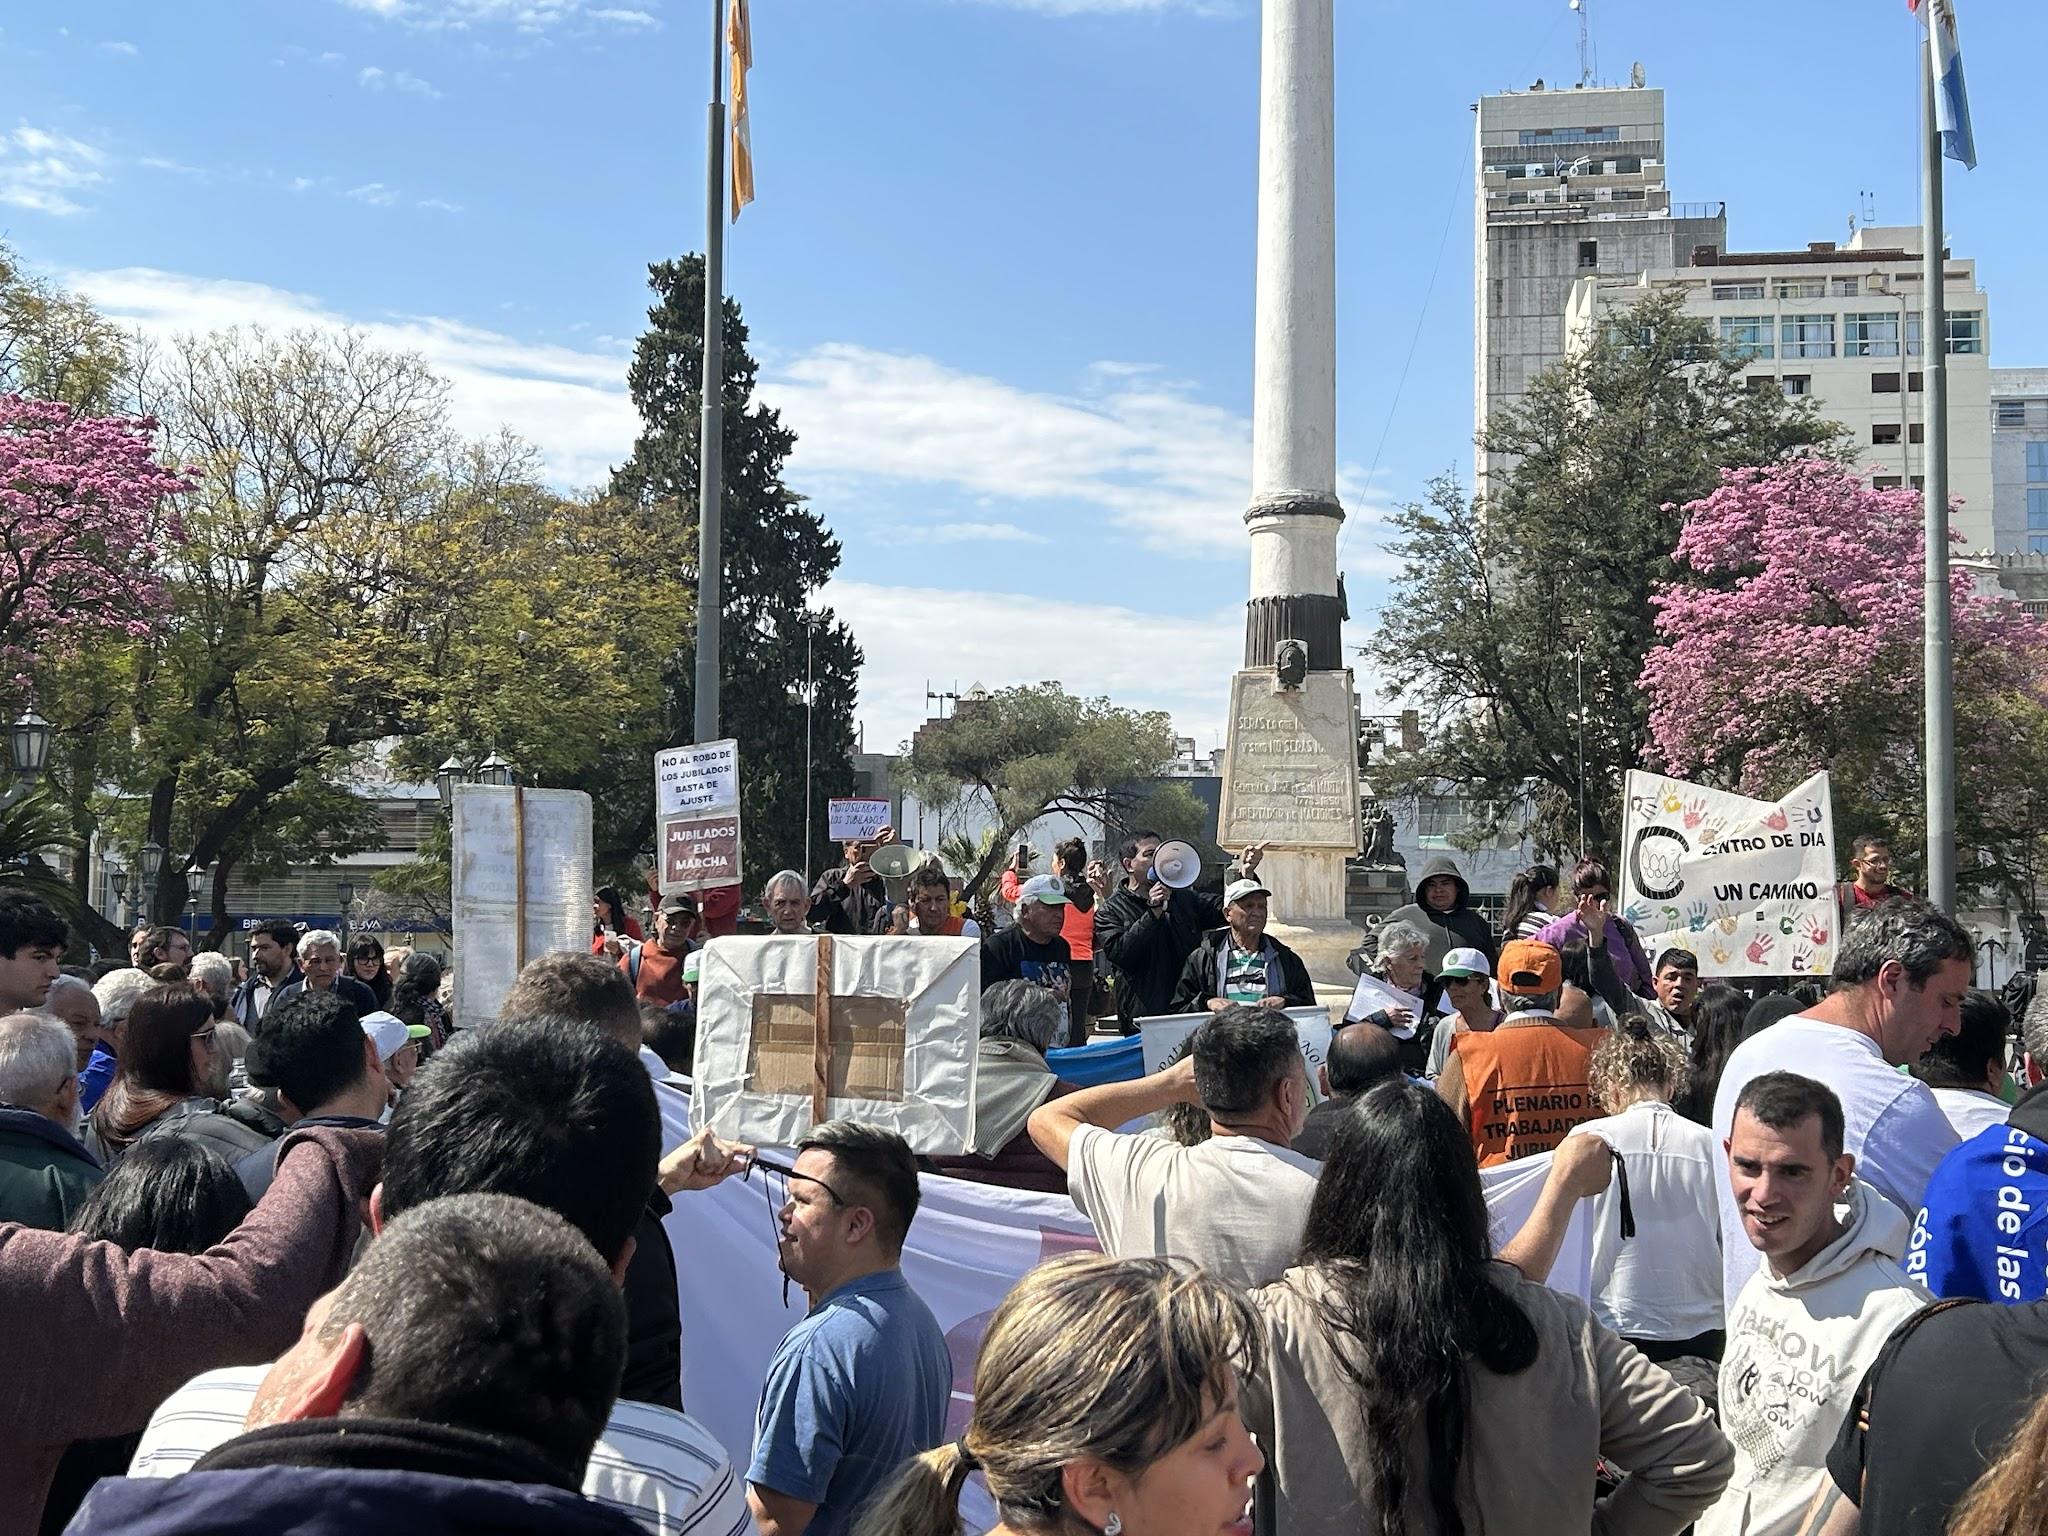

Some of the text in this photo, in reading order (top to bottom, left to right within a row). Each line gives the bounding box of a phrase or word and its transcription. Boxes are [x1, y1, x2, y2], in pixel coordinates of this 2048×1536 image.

[661, 750, 732, 768] NO AL ROBO DE
[661, 772, 679, 782] LOS
[675, 780, 719, 794] BASTA DE
[679, 794, 714, 806] AJUSTE
[881, 804, 887, 813] A
[830, 815, 843, 825] LOS
[668, 826, 736, 842] JUBILADOS
[858, 826, 876, 837] NO
[693, 842, 711, 854] EN
[1770, 833, 1794, 849] DE
[1800, 832, 1826, 848] DIA
[675, 856, 729, 871] MARCHA
[1713, 882, 1744, 902] UN
[1492, 1093, 1582, 1115] PLENARIO
[1997, 1185, 2031, 1235] de
[1996, 1245, 2030, 1300] las
